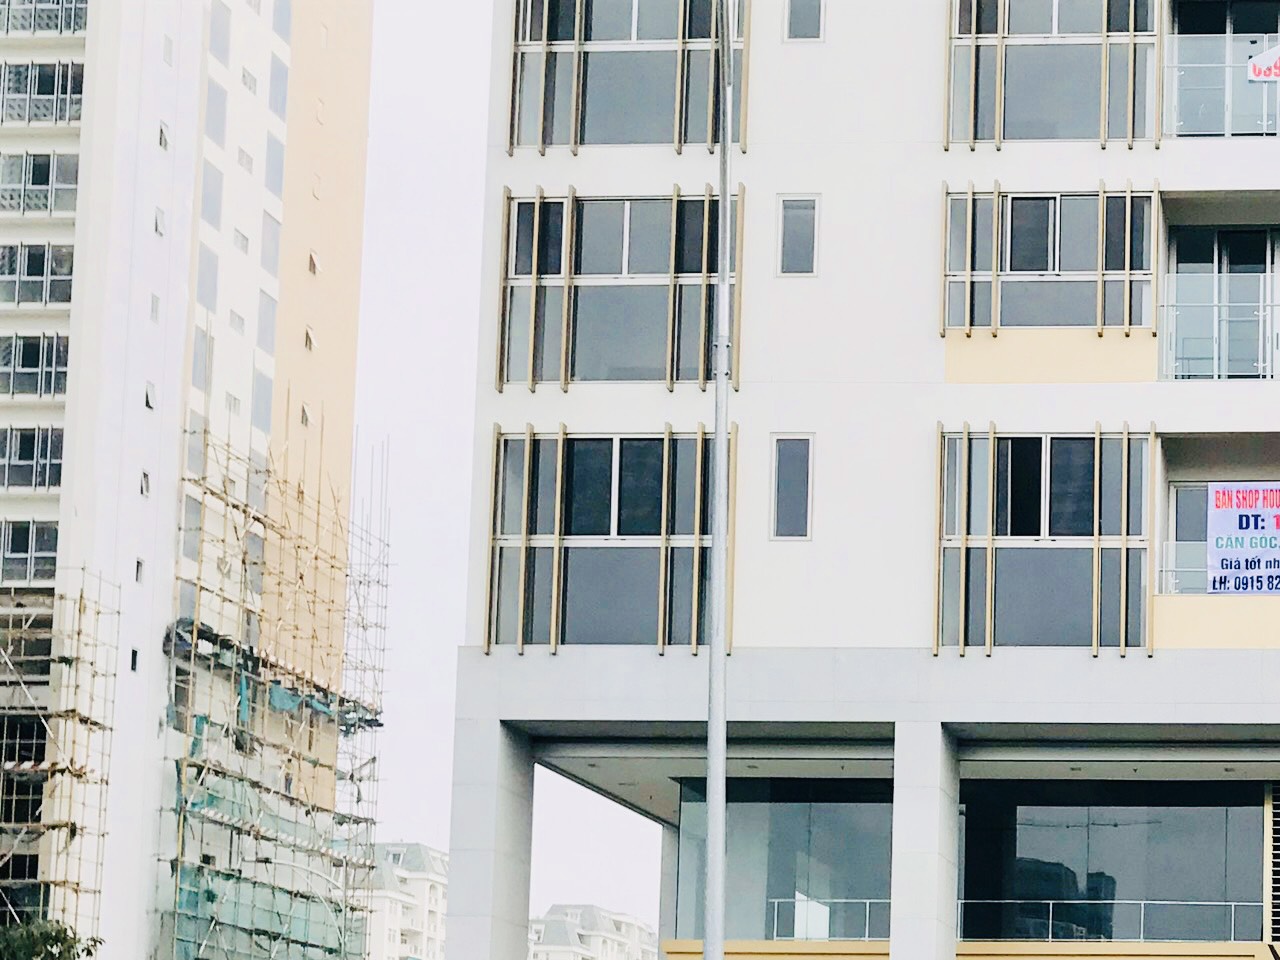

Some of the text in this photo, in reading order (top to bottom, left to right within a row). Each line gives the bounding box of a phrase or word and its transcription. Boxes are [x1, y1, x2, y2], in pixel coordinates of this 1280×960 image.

[1235, 489, 1260, 509] SHOP
[1238, 514, 1265, 530] DT:
[1215, 534, 1245, 549] CĂN
[1220, 557, 1241, 570] Giá
[1244, 555, 1261, 570] tốt
[1233, 575, 1263, 591] 0915
